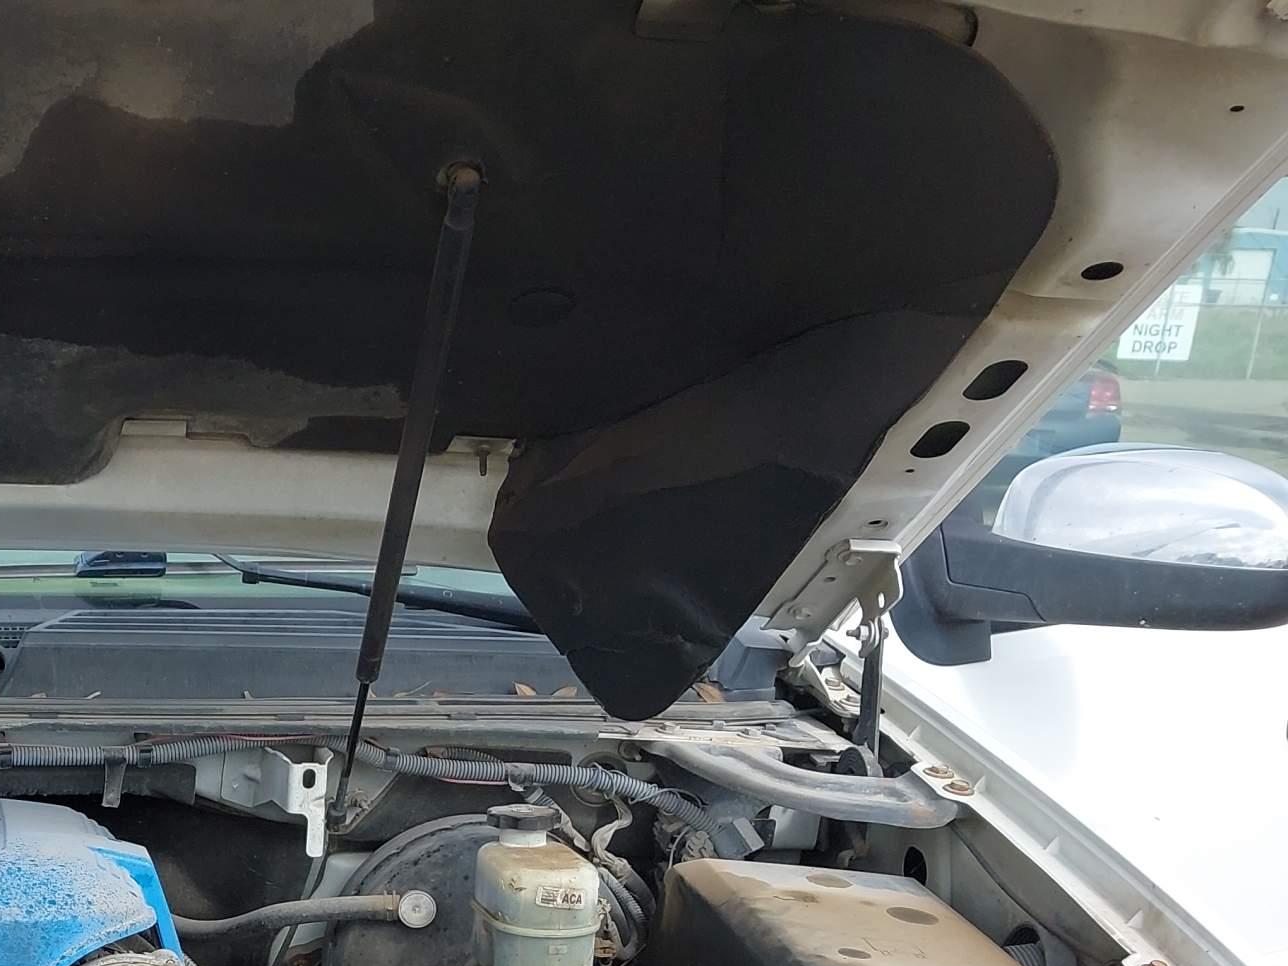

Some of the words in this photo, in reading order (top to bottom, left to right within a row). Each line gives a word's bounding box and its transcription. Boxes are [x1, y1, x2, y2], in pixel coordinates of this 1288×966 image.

[1133, 324, 1184, 337] NIGHT
[1131, 340, 1178, 354] DROP
[562, 893, 582, 905] ACA
